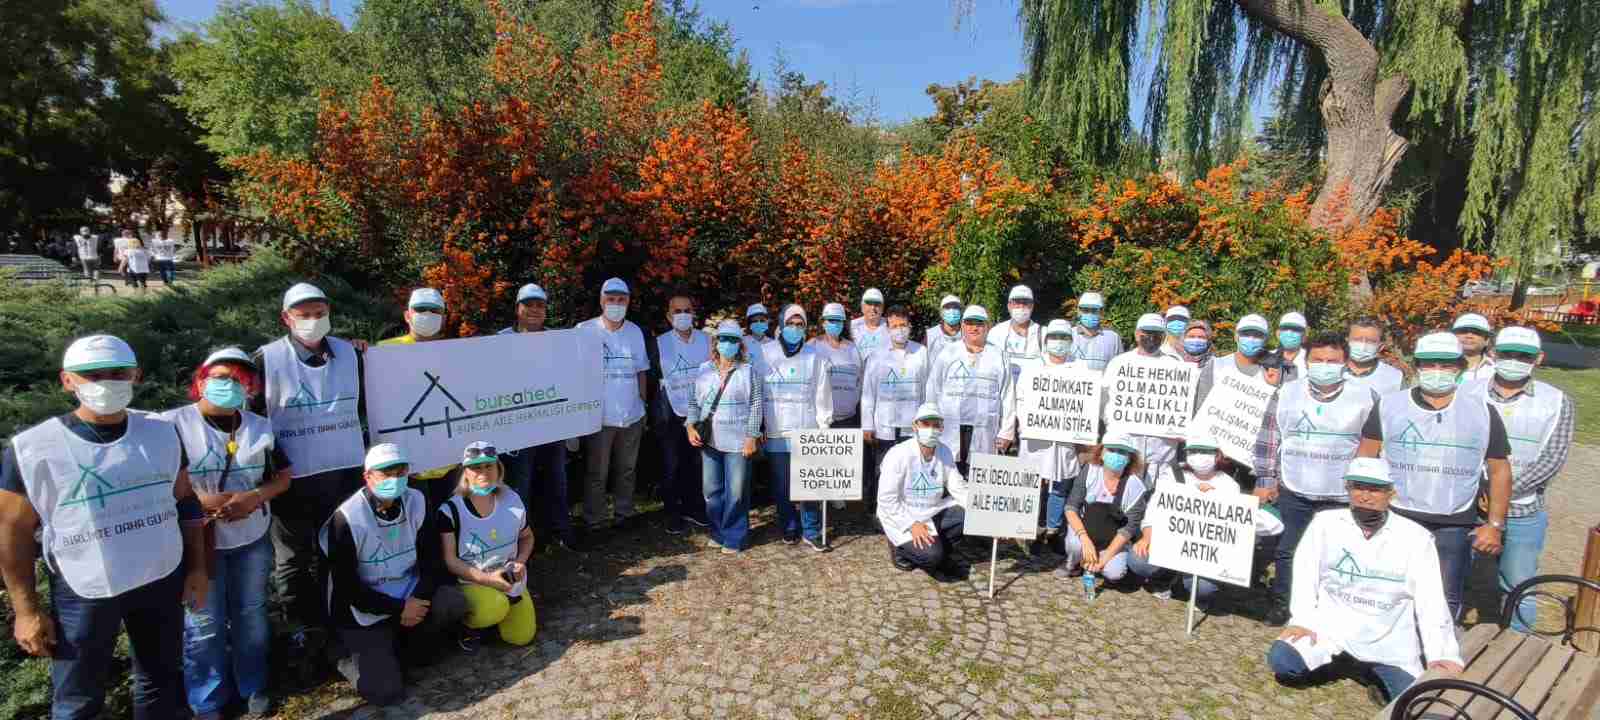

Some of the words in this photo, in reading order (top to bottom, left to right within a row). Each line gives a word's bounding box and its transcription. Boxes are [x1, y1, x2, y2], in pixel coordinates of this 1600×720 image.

[1117, 363, 1145, 379] AİLE
[1148, 366, 1191, 383] HEKİMİ
[1032, 374, 1051, 392] BİZİ
[1052, 376, 1093, 396] DİKKATE
[1116, 380, 1189, 398] OLMADAN
[1222, 376, 1270, 400] STANDAR
[475, 385, 557, 411] bursahed
[1038, 396, 1084, 414] ALMAYAN
[1114, 394, 1188, 412] SAĞLIKLI
[1113, 409, 1187, 428] OLUNMAZ
[1234, 400, 1264, 418] UYGU
[1027, 413, 1061, 430] BAKAN
[1062, 414, 1092, 432] İSTİFA
[1209, 425, 1255, 451] İSTİYORU
[801, 446, 853, 456] DOKTOR
[801, 480, 851, 490] TOPLUM
[972, 467, 987, 484] TEK
[971, 492, 991, 510] AİLE
[1157, 491, 1254, 526] ANGARYALARA
[1168, 515, 1195, 537] SON
[1198, 521, 1237, 545] VERİN
[1180, 540, 1219, 563] ARTIK
